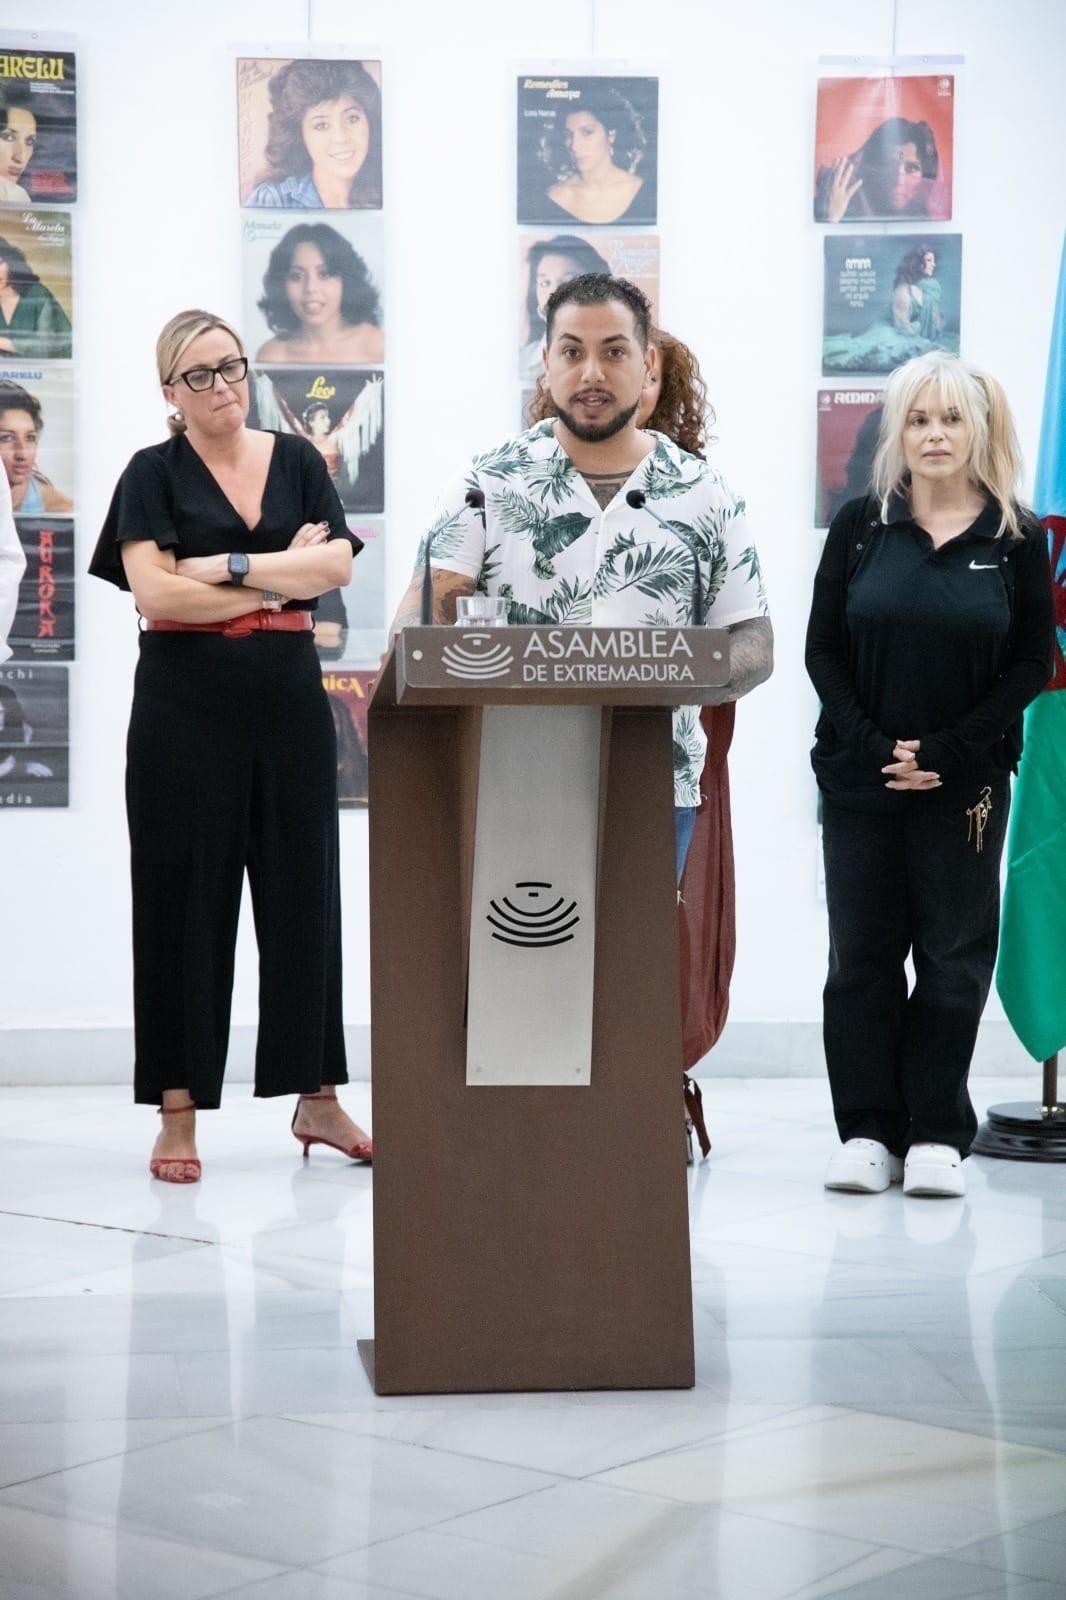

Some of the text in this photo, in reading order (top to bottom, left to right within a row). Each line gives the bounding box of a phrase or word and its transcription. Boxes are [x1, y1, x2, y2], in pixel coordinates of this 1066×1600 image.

[523, 630, 694, 659] ASAMBLEA
[523, 664, 695, 682] DE EXTREMADURA
